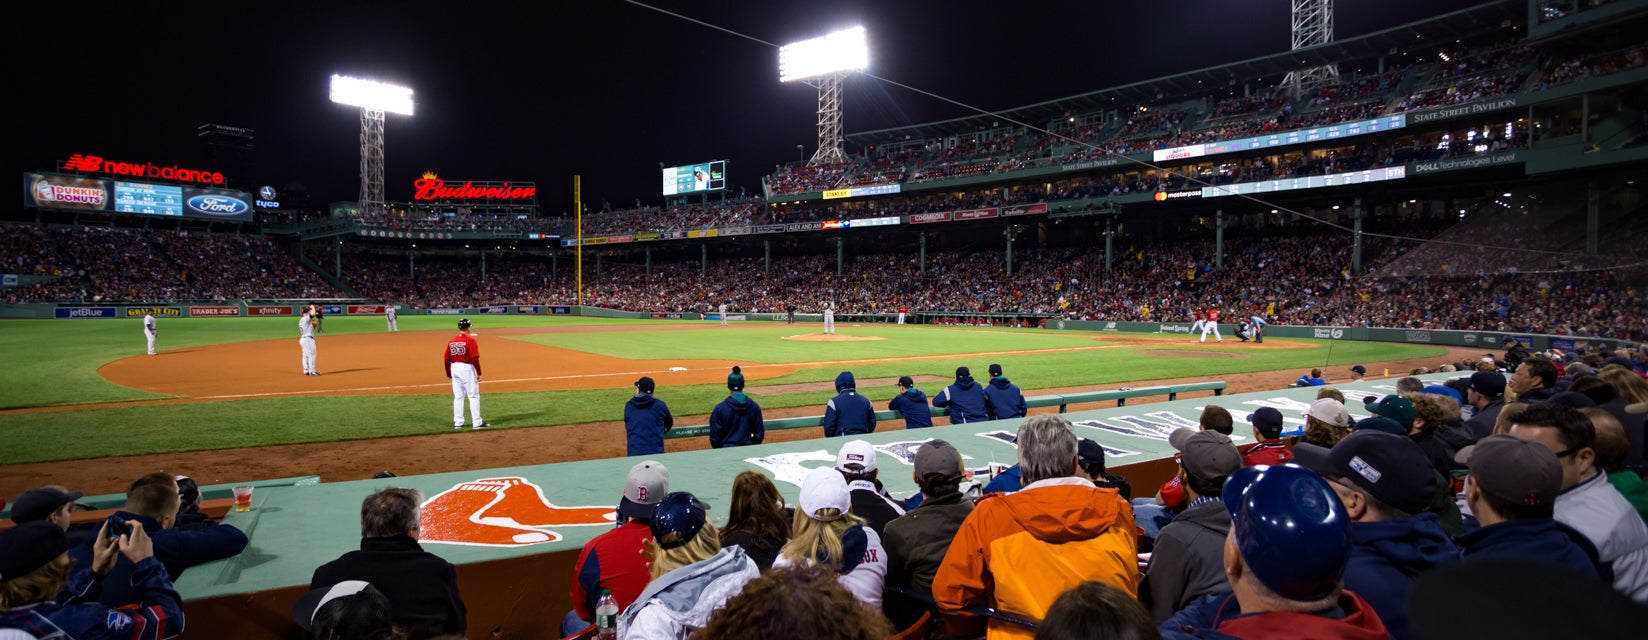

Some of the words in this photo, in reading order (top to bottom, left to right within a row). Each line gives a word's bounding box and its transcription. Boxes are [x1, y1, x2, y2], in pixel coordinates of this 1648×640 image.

[1414, 112, 1439, 122] STATE
[1440, 106, 1469, 118] STREET
[1472, 99, 1517, 113] PAVILION
[1415, 163, 1440, 173] DELL
[1439, 156, 1491, 171] Technologies
[1492, 152, 1516, 163] Level
[104, 160, 146, 177] new
[147, 162, 224, 185] balance
[1388, 167, 1404, 177] 5TH
[414, 178, 536, 200] Budweiser
[825, 190, 848, 198] STANLEY
[1168, 191, 1202, 199] masterpass
[56, 194, 101, 205] DONUTS
[200, 197, 238, 212] Ford
[256, 200, 280, 208] tyco
[69, 308, 103, 318] jetBlue
[163, 307, 180, 316] CITY
[258, 306, 282, 315] xfinity
[449, 341, 467, 355] 55
[636, 485, 649, 502] B
[861, 549, 879, 565] OX
